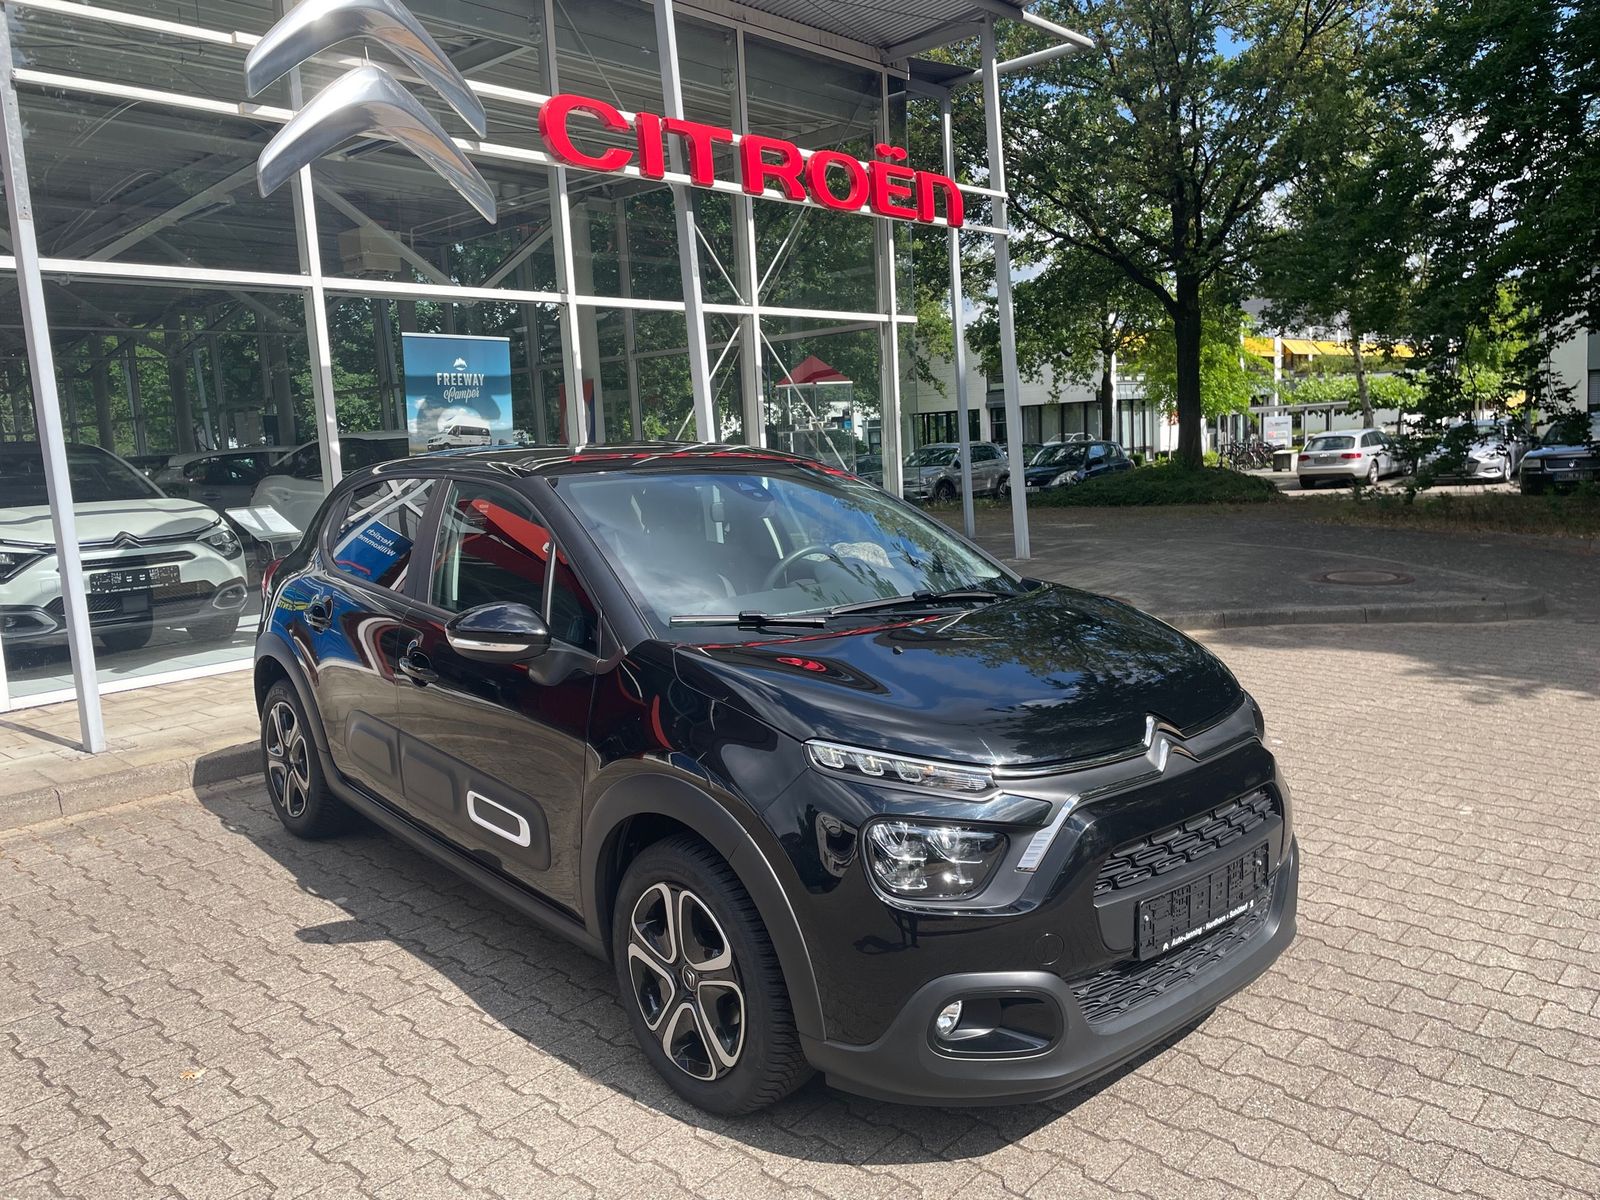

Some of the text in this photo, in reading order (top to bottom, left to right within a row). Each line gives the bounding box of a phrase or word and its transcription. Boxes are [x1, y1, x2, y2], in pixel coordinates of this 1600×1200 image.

[538, 93, 964, 228] CITROËN
[436, 372, 485, 386] FREEWAY
[443, 386, 480, 404] Camper
